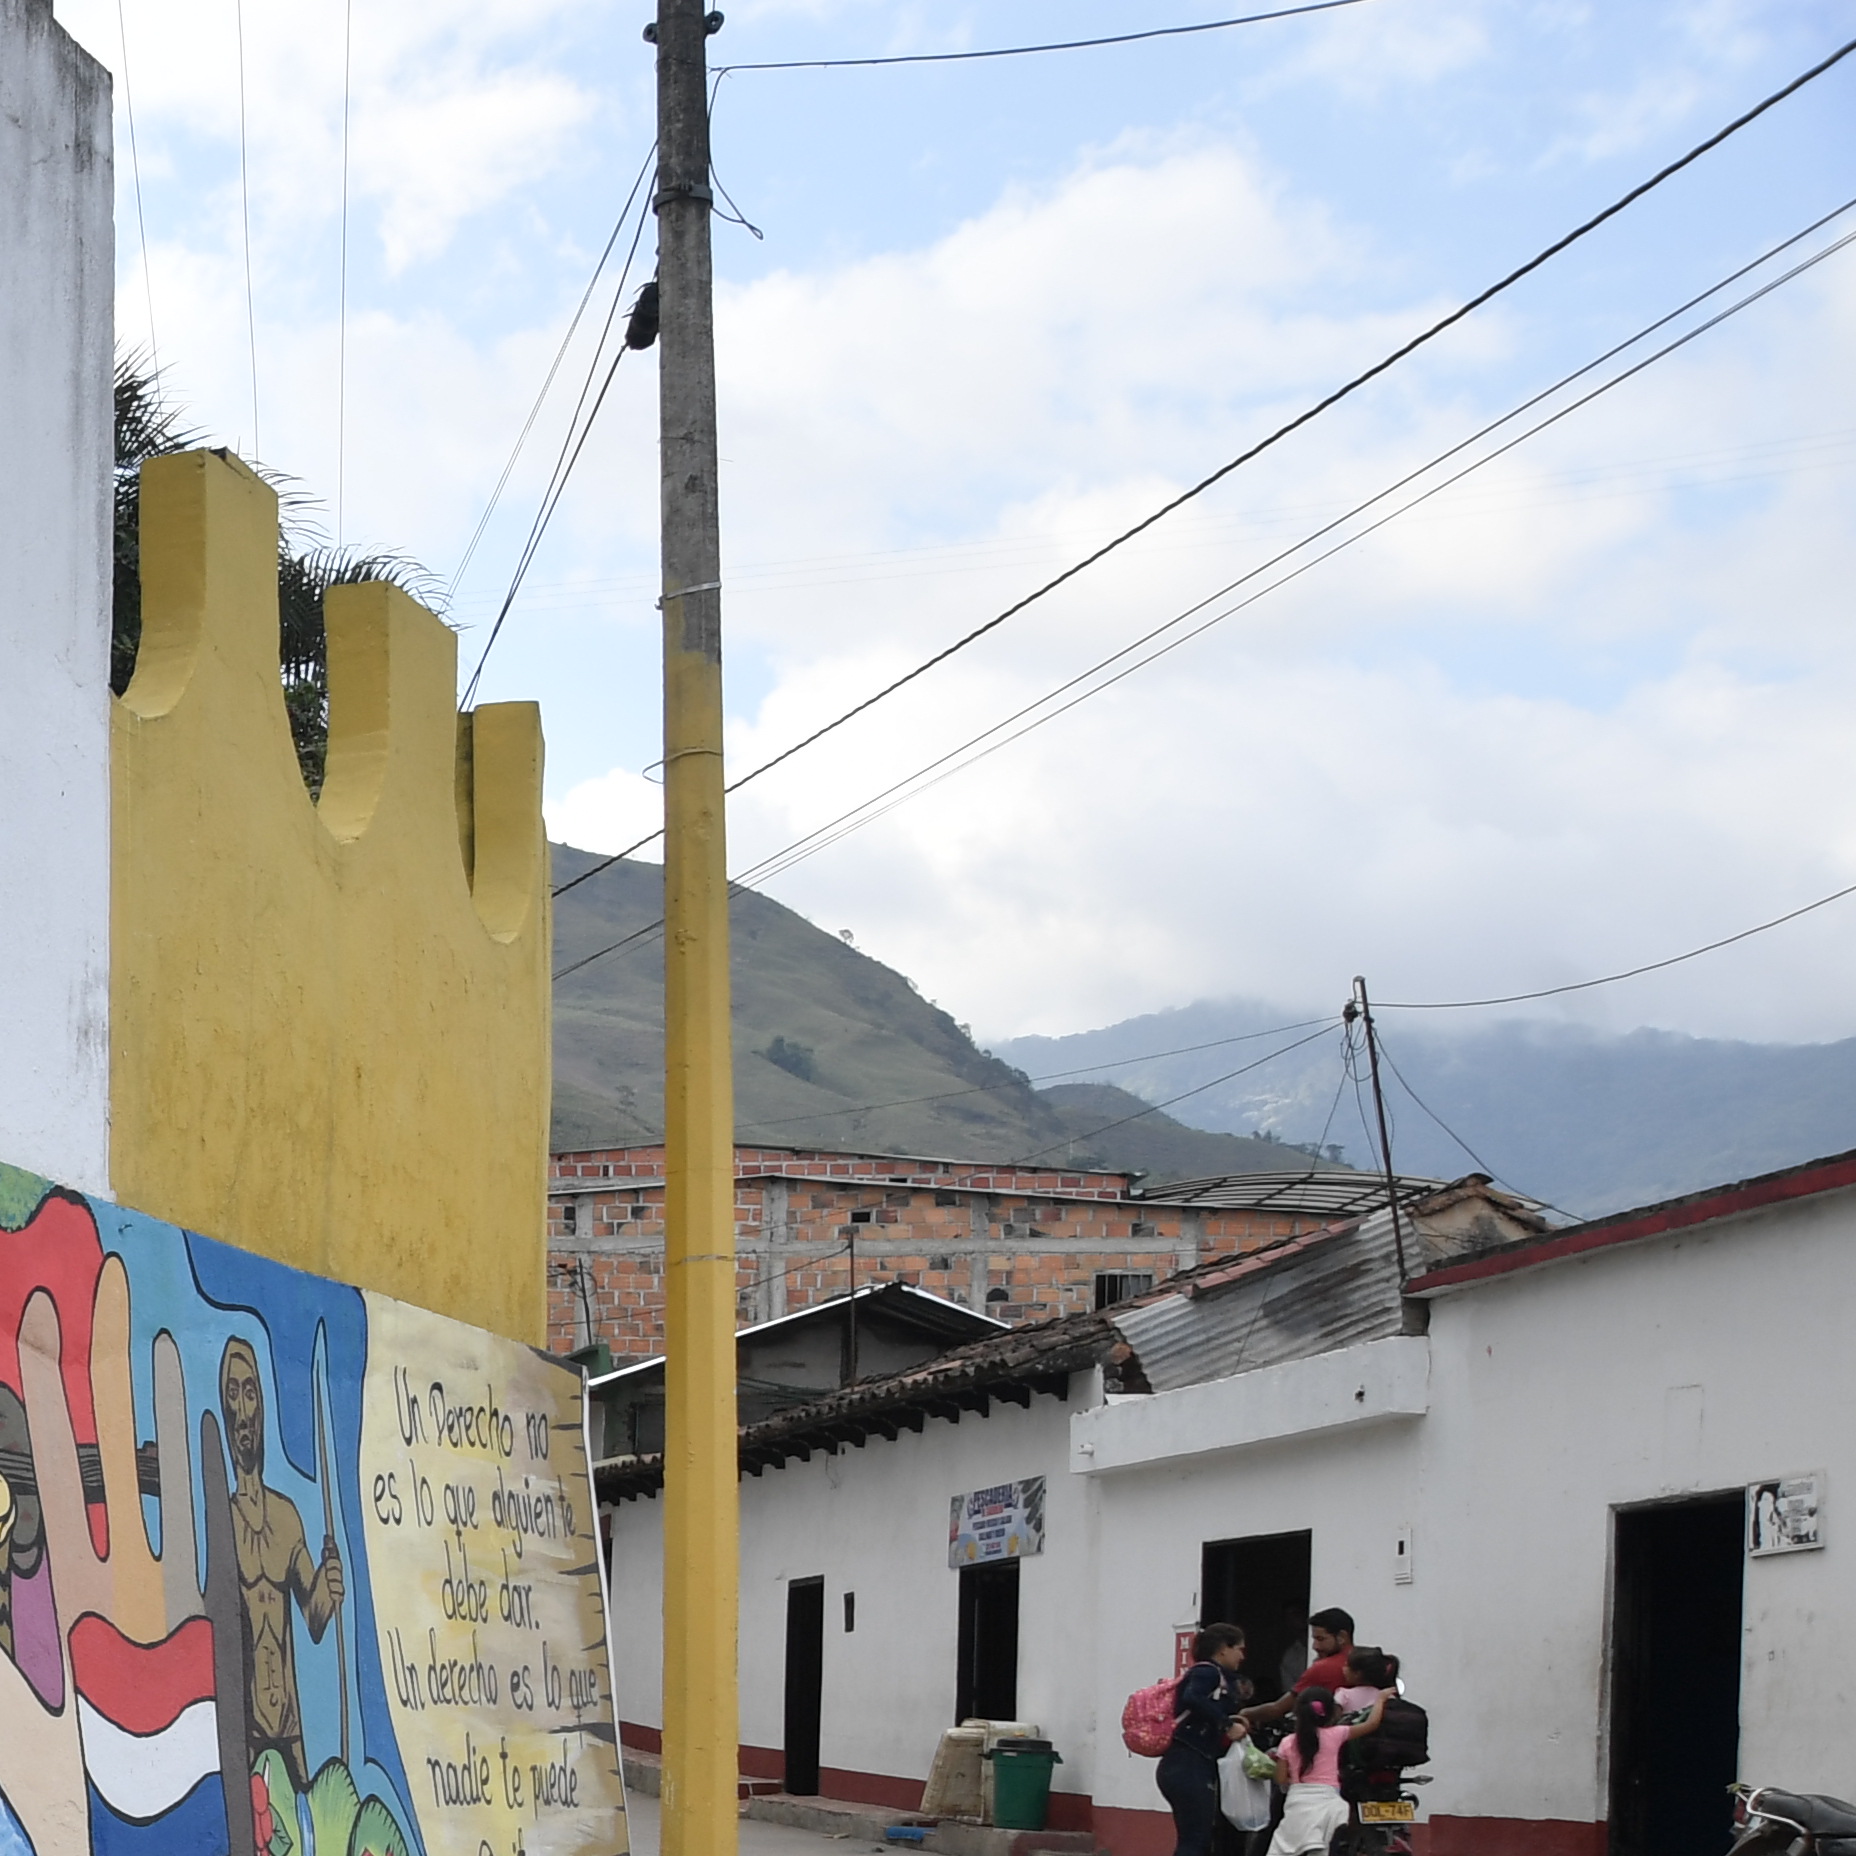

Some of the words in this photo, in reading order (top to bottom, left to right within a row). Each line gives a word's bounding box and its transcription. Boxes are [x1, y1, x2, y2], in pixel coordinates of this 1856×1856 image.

[393, 1365, 428, 1447] Un
[429, 1382, 514, 1458] Derecho
[526, 1412, 549, 1461] no
[373, 1472, 402, 1526] es
[410, 1458, 434, 1528] lo
[444, 1483, 478, 1552] que
[492, 1466, 556, 1559] alguien
[556, 1474, 576, 1538] te
[442, 1540, 488, 1624] debe
[499, 1548, 540, 1630] dar.
[387, 1627, 425, 1711] Un
[427, 1627, 498, 1707] derecho
[510, 1665, 534, 1711] es
[543, 1641, 561, 1711] lo
[569, 1667, 598, 1749] que
[427, 1731, 492, 1807] nadie
[499, 1736, 524, 1809] te
[530, 1737, 579, 1820] puede
